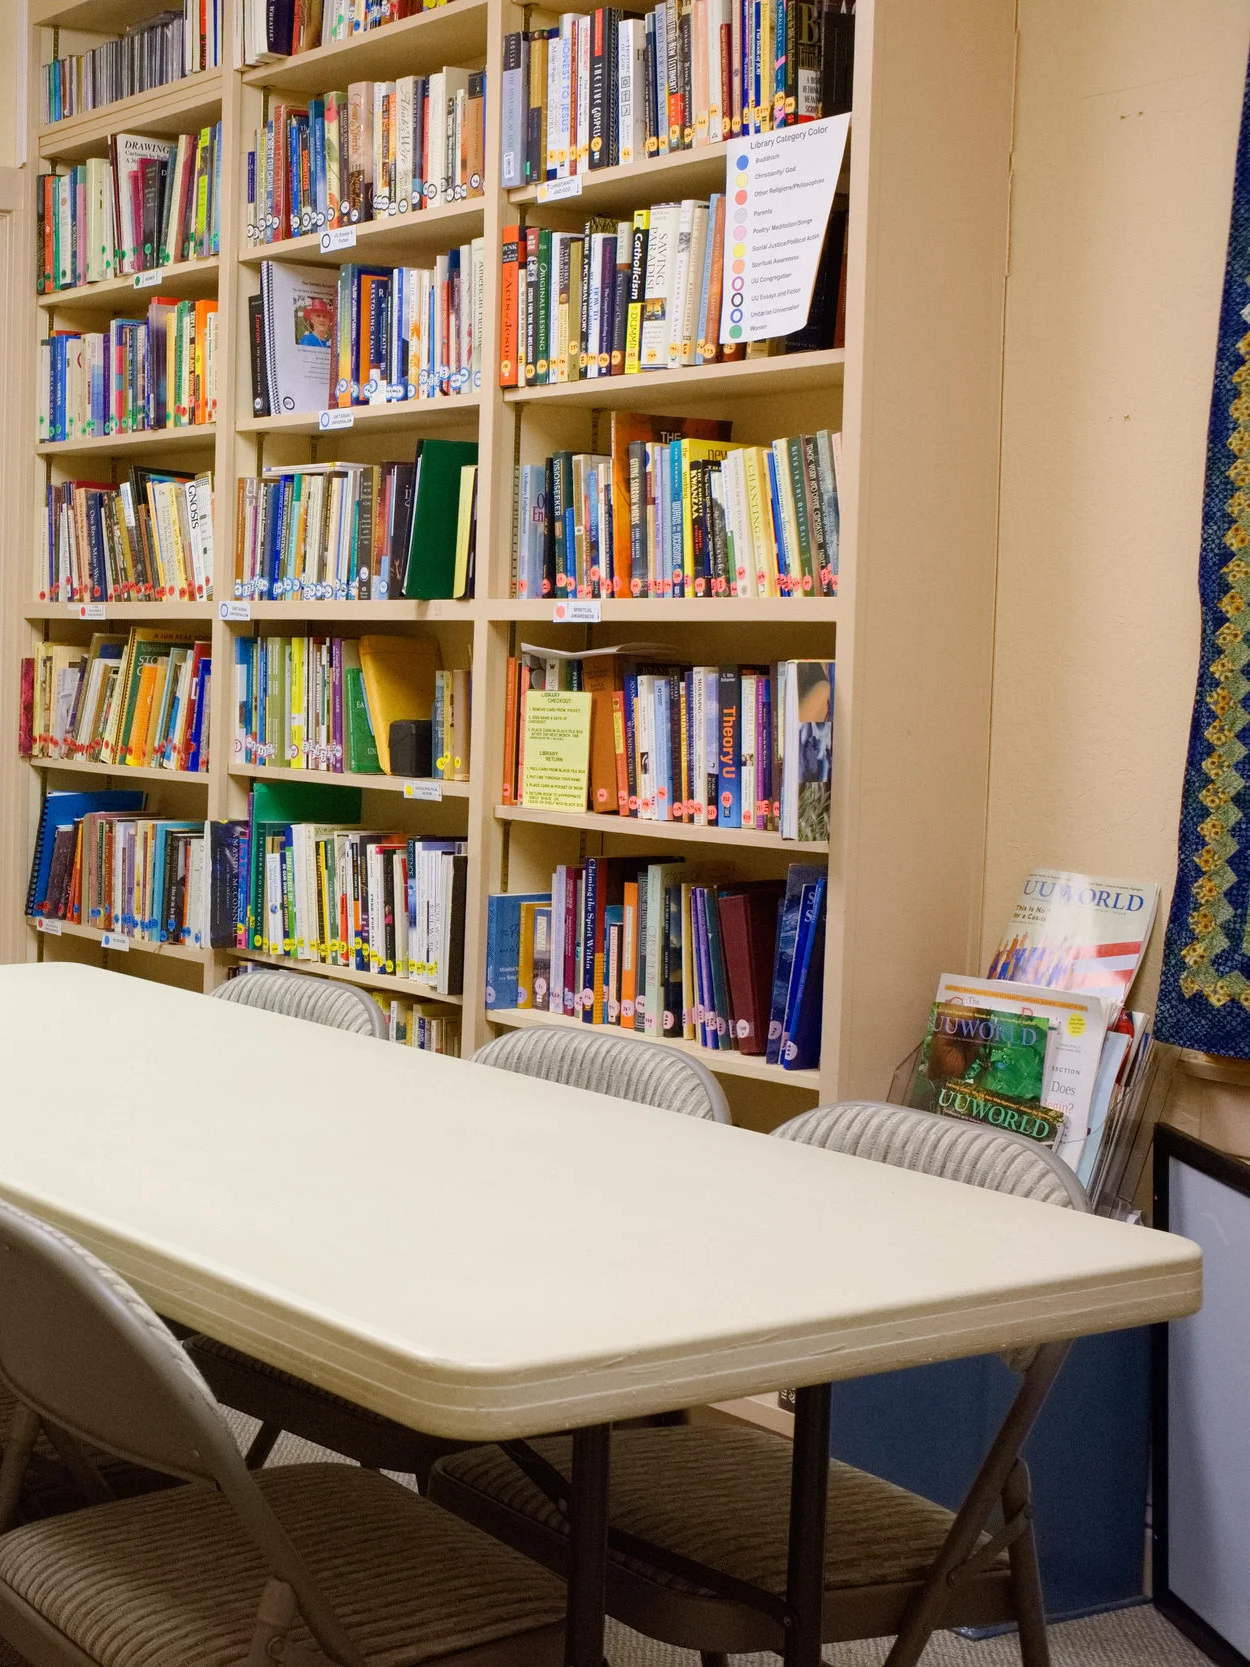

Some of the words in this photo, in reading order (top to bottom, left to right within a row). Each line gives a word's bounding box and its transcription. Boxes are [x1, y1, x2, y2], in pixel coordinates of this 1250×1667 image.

[667, 9, 676, 29] WROTE
[668, 29, 676, 40] THE
[508, 36, 516, 67] CROSSAN
[561, 37, 570, 80] HONEST
[668, 41, 678, 56] NEW
[594, 62, 603, 80] THE
[669, 57, 678, 93] TESTAMENT?
[561, 85, 570, 99] TO
[593, 83, 602, 105] FIVE
[349, 94, 365, 122] Four
[400, 85, 411, 132] Ahab's
[561, 103, 570, 133] JESUS
[592, 107, 601, 137] GOSPELS
[124, 140, 169, 154] DRAWING
[266, 133, 274, 158] ROBERT
[349, 122, 364, 156] Spirits
[401, 132, 412, 165] Wife
[750, 136, 775, 150] Library
[776, 130, 807, 145] Category
[807, 125, 829, 137] Color
[755, 153, 780, 164] Buddhism
[785, 165, 797, 174] God
[266, 159, 274, 192] FULGHUM
[754, 189, 768, 198] Other
[753, 208, 773, 217] Parents
[771, 217, 813, 232] Meditation/Songs
[752, 244, 766, 253] Social
[767, 236, 807, 250] Justice/Political
[806, 232, 820, 242] Action
[631, 233, 643, 300] Catholicism
[646, 227, 658, 294] PARADISE
[655, 233, 668, 286] SAVING
[751, 258, 772, 269] Spiritual
[772, 254, 800, 265] Awareness
[539, 263, 548, 309] ORIGINAL
[750, 277, 758, 285] UU
[758, 271, 792, 284] Congregation
[751, 294, 759, 302] UU
[759, 291, 776, 302] Essays
[776, 290, 786, 298] and
[786, 286, 802, 296] Fiction
[593, 310, 599, 321] TO
[750, 308, 772, 318] Unitarian
[750, 323, 767, 333] Women
[661, 431, 682, 444] THE
[630, 458, 639, 478] GIVING
[791, 446, 799, 466] KEYS
[681, 471, 689, 499] wedding
[794, 471, 800, 480] TO
[552, 459, 561, 517] VISIONSEEKER
[631, 479, 640, 504] SORROW
[690, 470, 698, 519] KWANZAA
[748, 464, 760, 535] CHANTING
[794, 484, 802, 499] THE
[188, 485, 200, 530] GNOSIS
[631, 505, 640, 525] WORDS
[672, 501, 681, 525] WORDS
[796, 502, 804, 522] OPEN
[280, 507, 288, 559] CONVERSATIONS
[799, 526, 807, 547] GATE
[672, 533, 681, 565] OCCASIONS
[720, 705, 737, 765] Theory
[722, 767, 736, 779] U
[586, 858, 596, 897] Claiming
[231, 878, 239, 937] McCONNELL
[587, 898, 596, 911] the
[1023, 879, 1145, 912] UUWORLD
[585, 913, 595, 937] Spirit
[585, 939, 594, 969] Within
[609, 927, 617, 982] TOUCHSTONES
[967, 996, 981, 1006] The
[934, 1015, 1038, 1047] UUWORLD
[1051, 1080, 1076, 1096] Does
[938, 1087, 1050, 1139] UUWORLD
